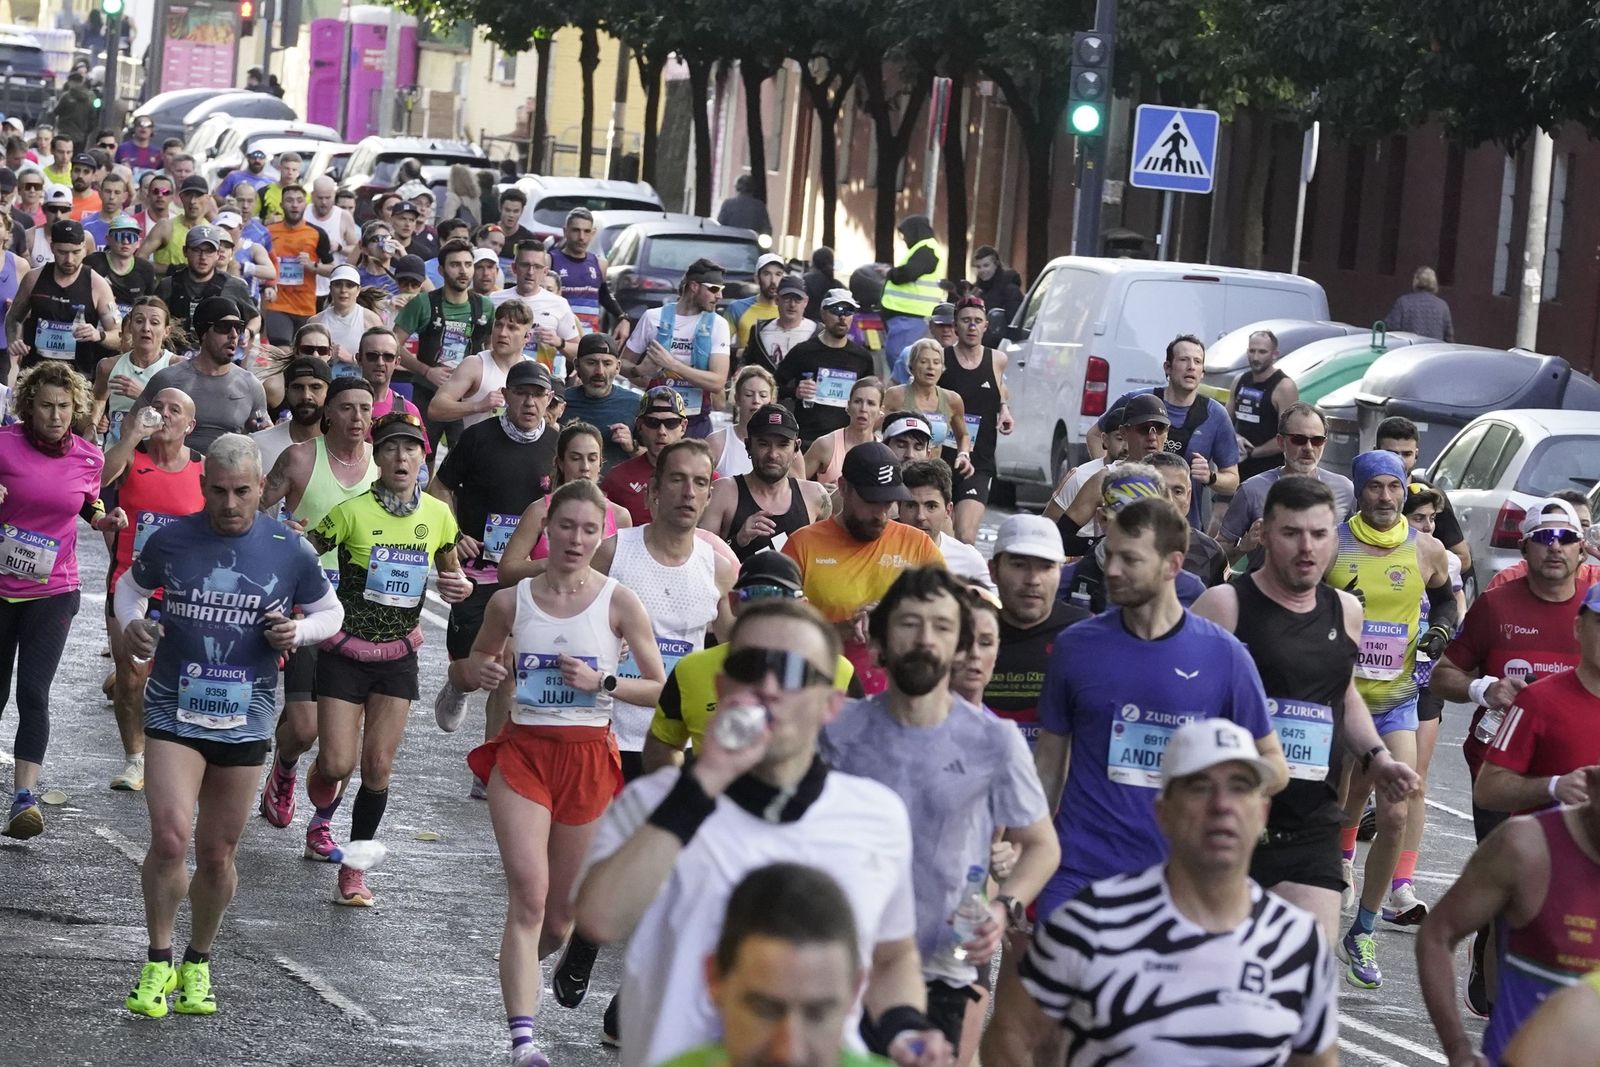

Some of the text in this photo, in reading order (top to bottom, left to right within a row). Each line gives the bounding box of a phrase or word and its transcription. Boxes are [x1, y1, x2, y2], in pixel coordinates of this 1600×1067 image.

[46, 341, 65, 350] LIAM
[828, 389, 844, 398] JAVI
[14, 546, 36, 560] 14762
[392, 551, 425, 563] ZURICH
[5, 555, 36, 573] RUTH
[390, 569, 409, 579] 8645
[385, 580, 410, 594] FITO
[191, 588, 262, 609] MEDIA
[166, 599, 258, 626] MARATÓN
[1367, 624, 1403, 635] ZURICH
[1365, 641, 1388, 651] 11401
[1357, 652, 1393, 667] DAVID
[205, 668, 247, 680] ZURICH
[205, 686, 228, 697] 9358
[538, 690, 575, 705] JUJU
[189, 697, 239, 715] RUBIÑO
[1283, 704, 1326, 720] ZURICH
[1144, 711, 1195, 726] ZURICH
[1281, 727, 1306, 740] 6475
